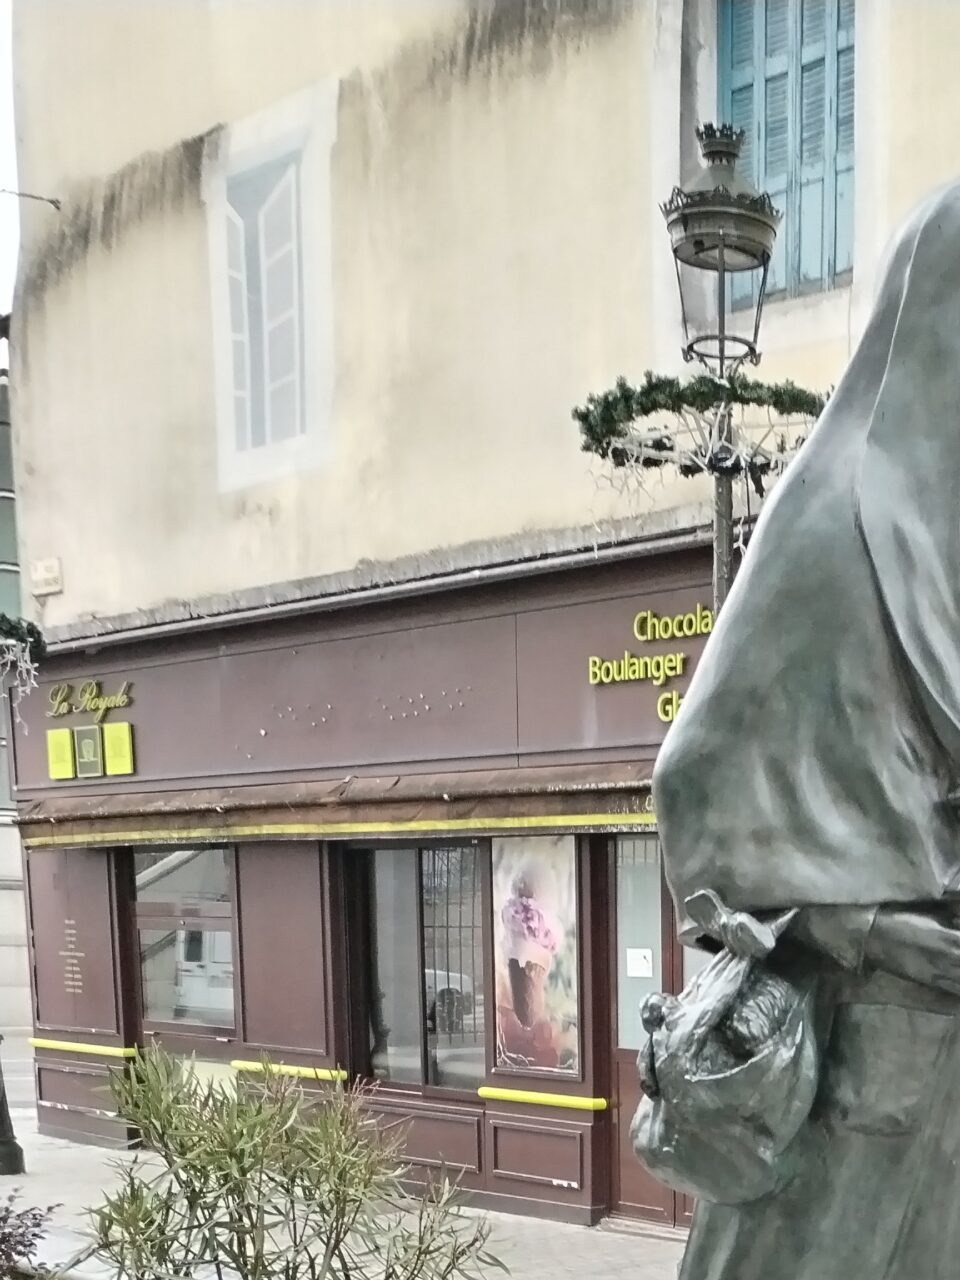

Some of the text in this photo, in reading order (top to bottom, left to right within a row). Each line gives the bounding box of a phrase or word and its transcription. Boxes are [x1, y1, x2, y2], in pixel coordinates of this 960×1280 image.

[634, 603, 715, 641] Chocola
[589, 650, 685, 685] Boulanger
[46, 680, 128, 723] La Royale
[657, 690, 685, 722] Gl
